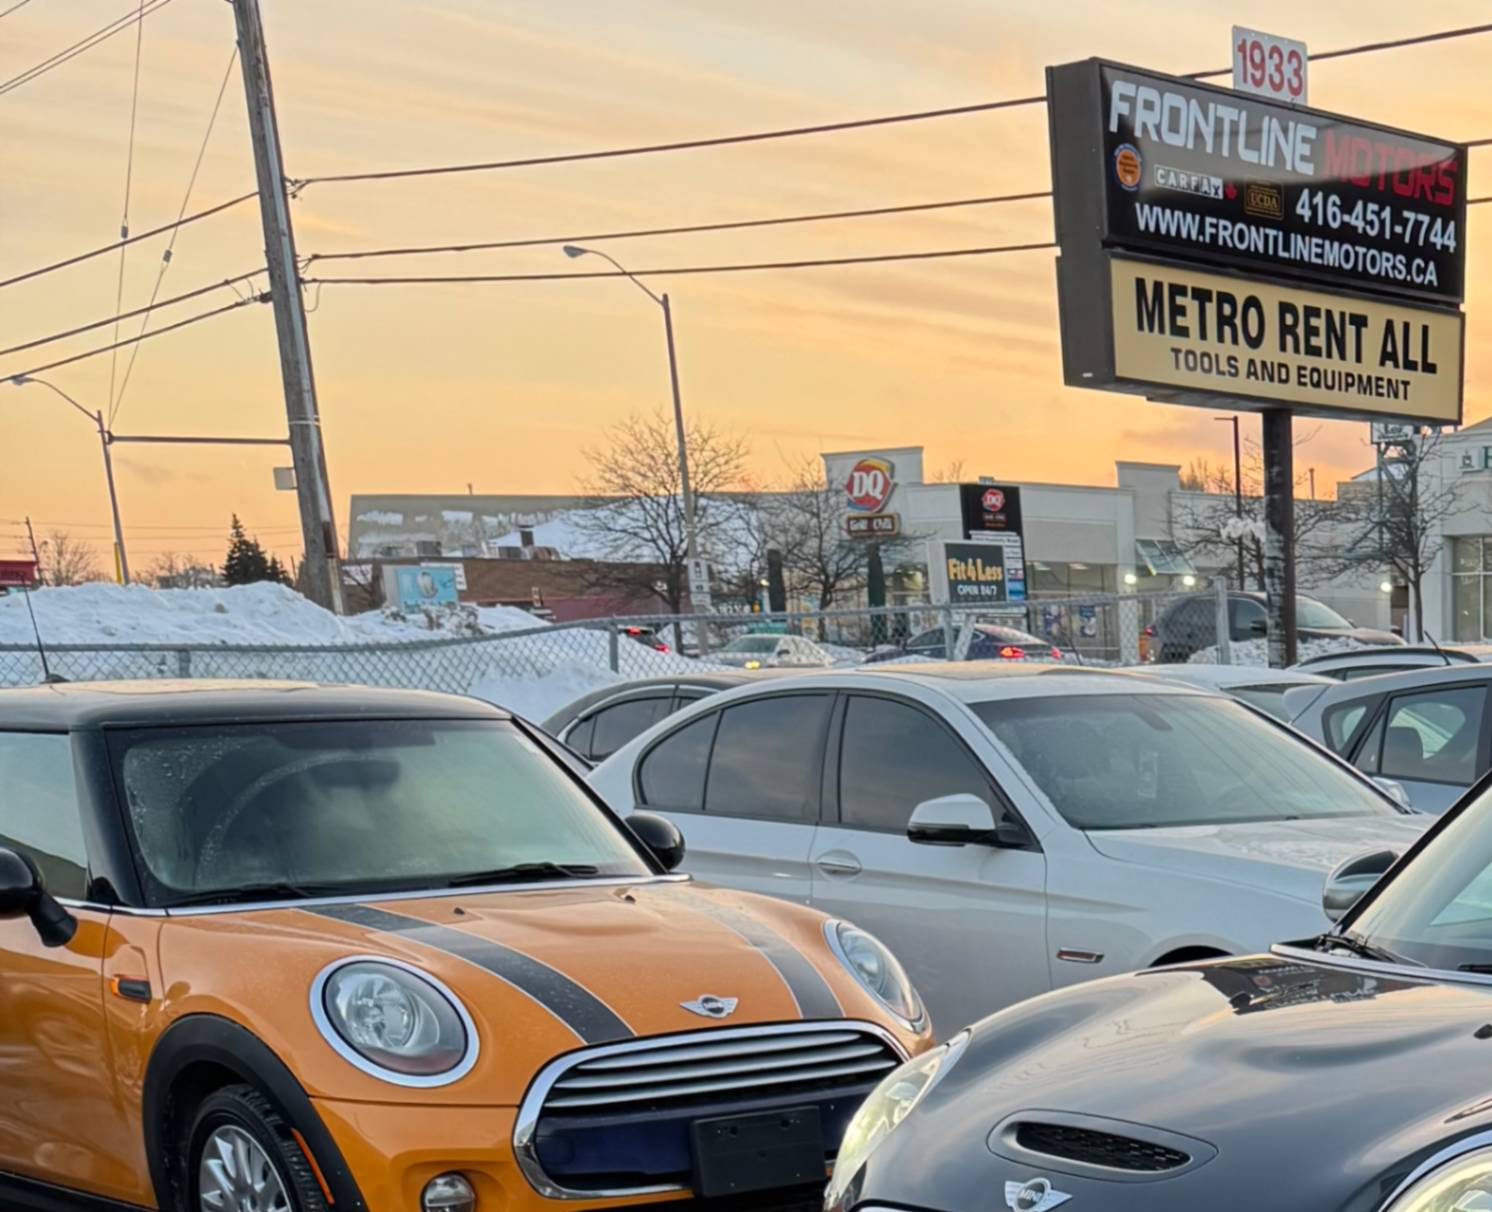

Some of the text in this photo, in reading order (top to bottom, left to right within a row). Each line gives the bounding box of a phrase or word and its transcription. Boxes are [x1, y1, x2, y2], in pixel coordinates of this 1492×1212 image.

[1237, 38, 1303, 97] 1933
[1109, 80, 1317, 176] FRONTLINE
[1322, 128, 1458, 206] MOTORS
[1155, 167, 1222, 198] CARFAX
[1250, 191, 1279, 208] UCDA
[1135, 202, 1438, 287] WWW.FRONTLINEMOTORS.CA
[1295, 187, 1457, 254] 416-451-7744
[1135, 276, 1438, 374] METRO RENT ALL
[1170, 347, 1411, 401] TOOLS AND EQUIPMENT
[852, 470, 884, 500] DQ
